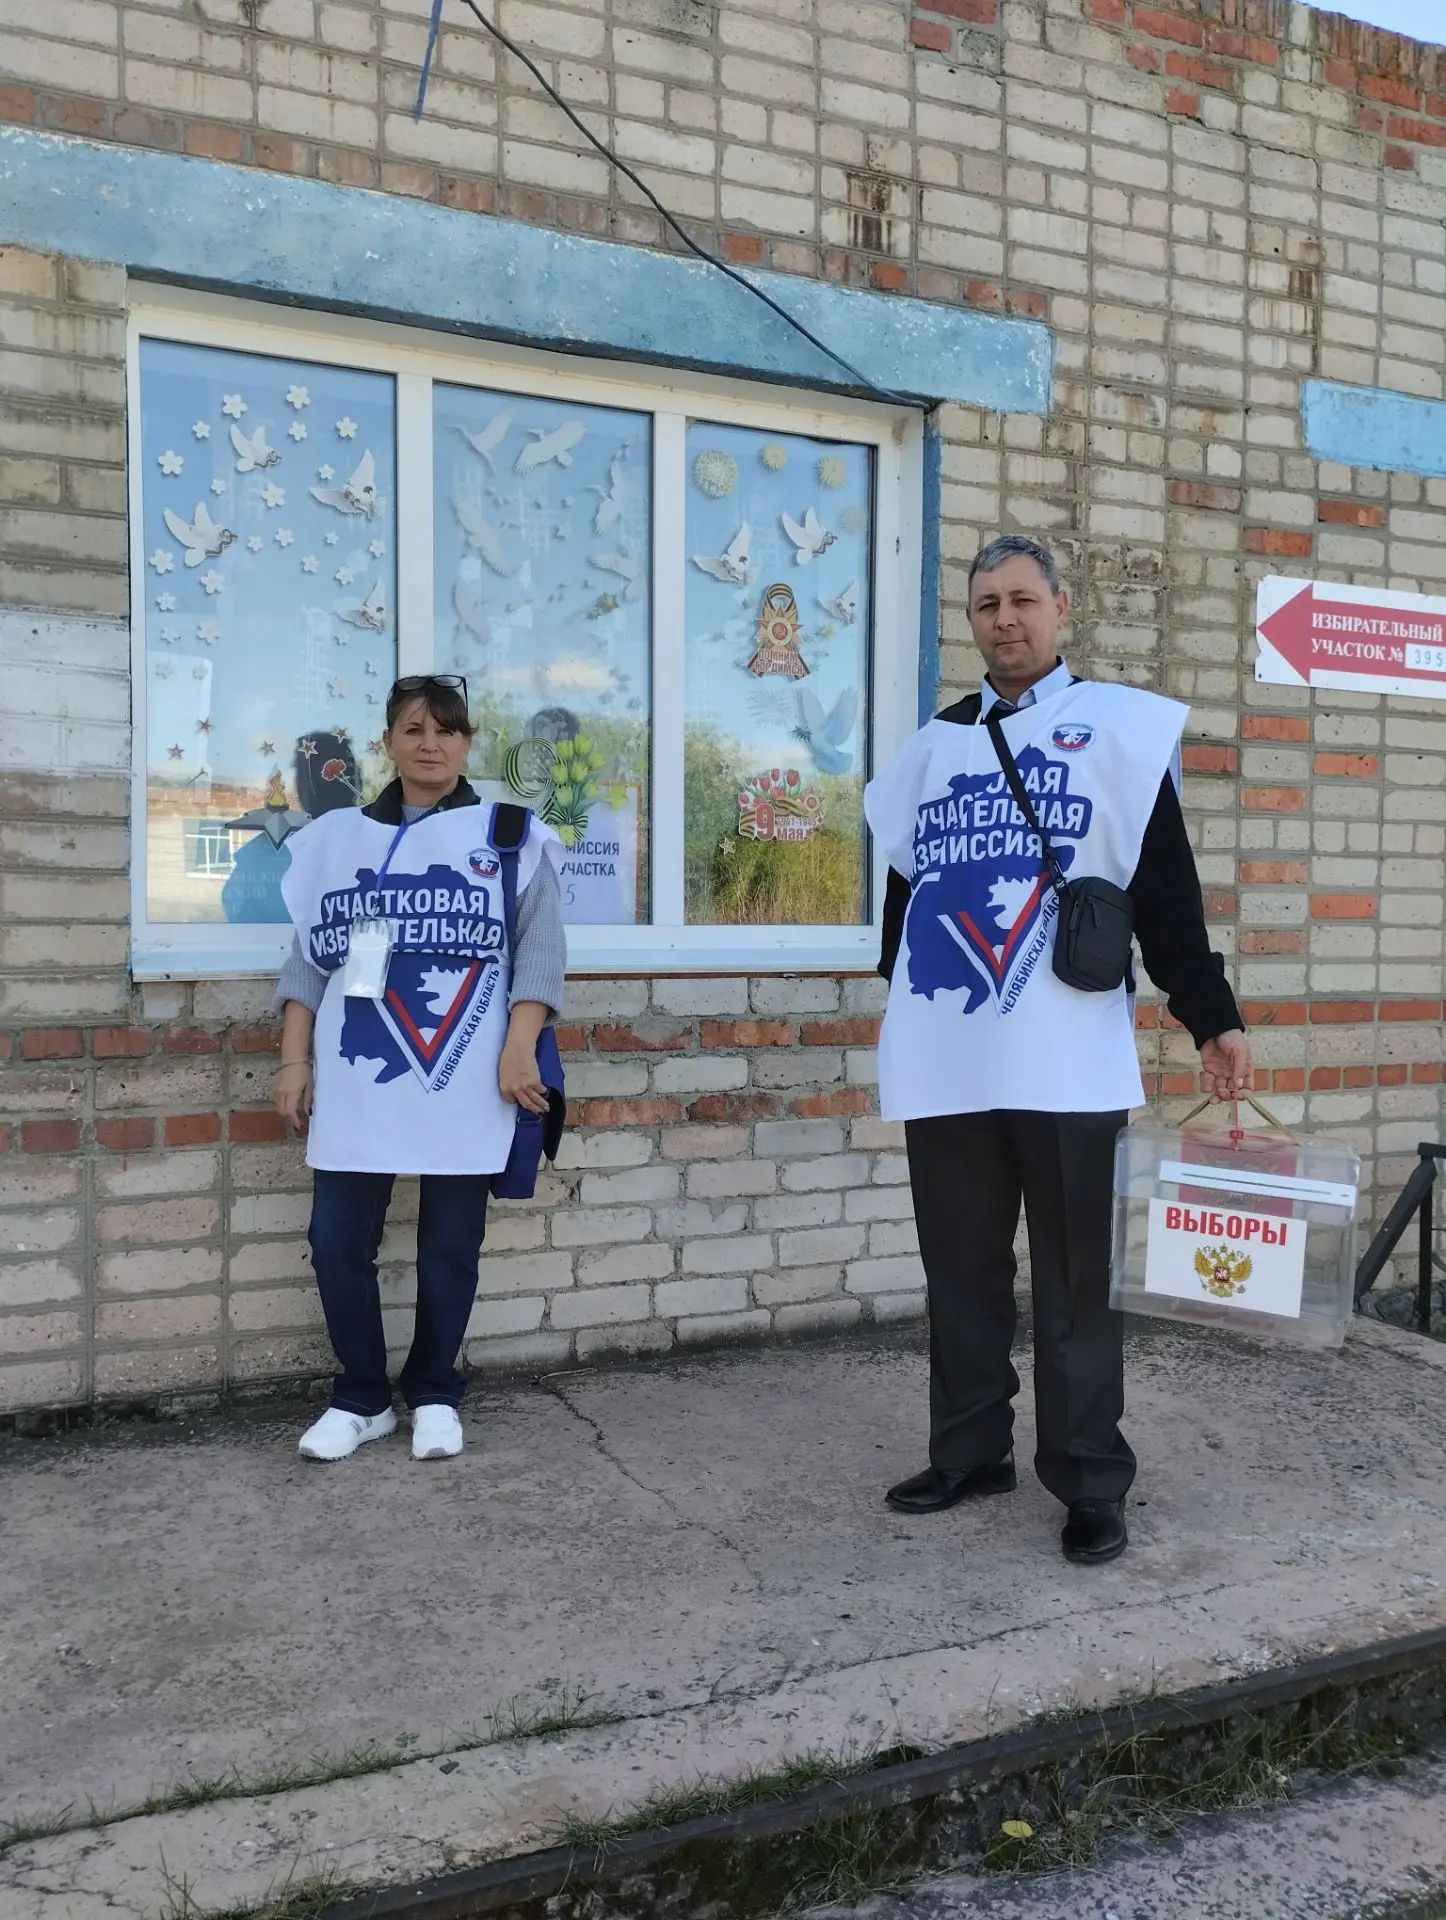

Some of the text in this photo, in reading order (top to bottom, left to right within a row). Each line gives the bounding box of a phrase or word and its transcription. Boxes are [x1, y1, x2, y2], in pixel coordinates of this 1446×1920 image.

[1311, 612, 1443, 642] ИЗБИРАТЕЛЬНЫЙ
[1311, 638, 1386, 661] УЧАСТОК
[1388, 646, 1403, 663] №
[756, 803, 775, 840] 9
[565, 840, 620, 856] МИССИЯ
[324, 887, 485, 924] УЧАСТКОВАЯ
[311, 918, 502, 958] ИЗБТЕЛЬНАЯ
[1001, 930, 1048, 1015] ЧЕЛЯБИНСКАЯ
[432, 969, 500, 1092] ЧЕЛЯБИНСКАЯ ОБЛАСТЬ
[1165, 1206, 1288, 1246] ВЫБОРЫ
